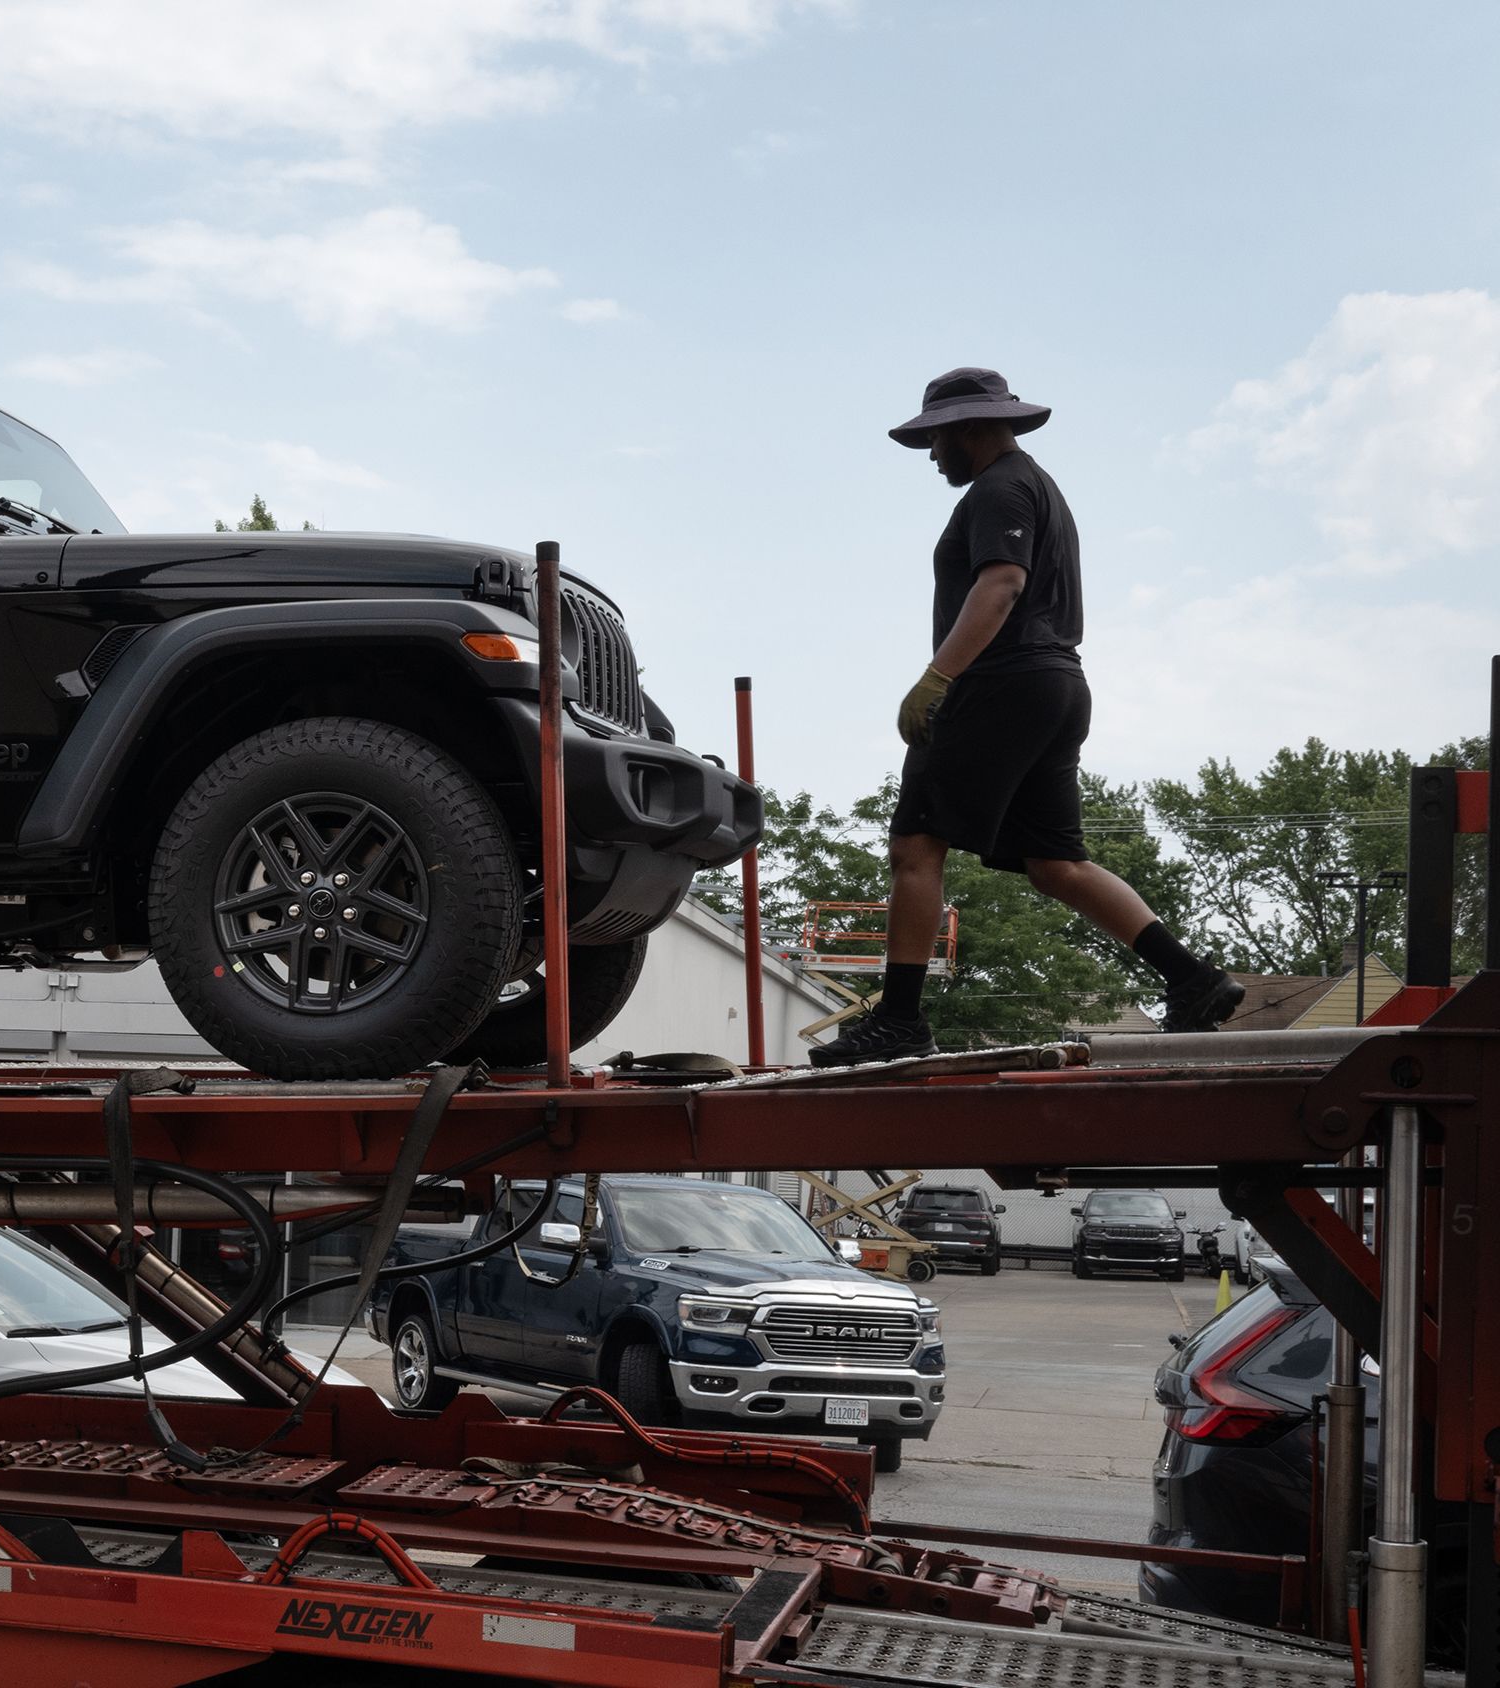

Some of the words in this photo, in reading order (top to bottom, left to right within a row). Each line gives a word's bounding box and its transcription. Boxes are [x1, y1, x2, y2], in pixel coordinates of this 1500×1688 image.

[1452, 1204, 1473, 1235] 5
[816, 1325, 879, 1338] RAM
[566, 1334, 587, 1343] RAM
[828, 1406, 861, 1420] 3112012
[276, 1598, 434, 1643] NEXTGEN
[403, 1639, 434, 1650] SYSTEMS
